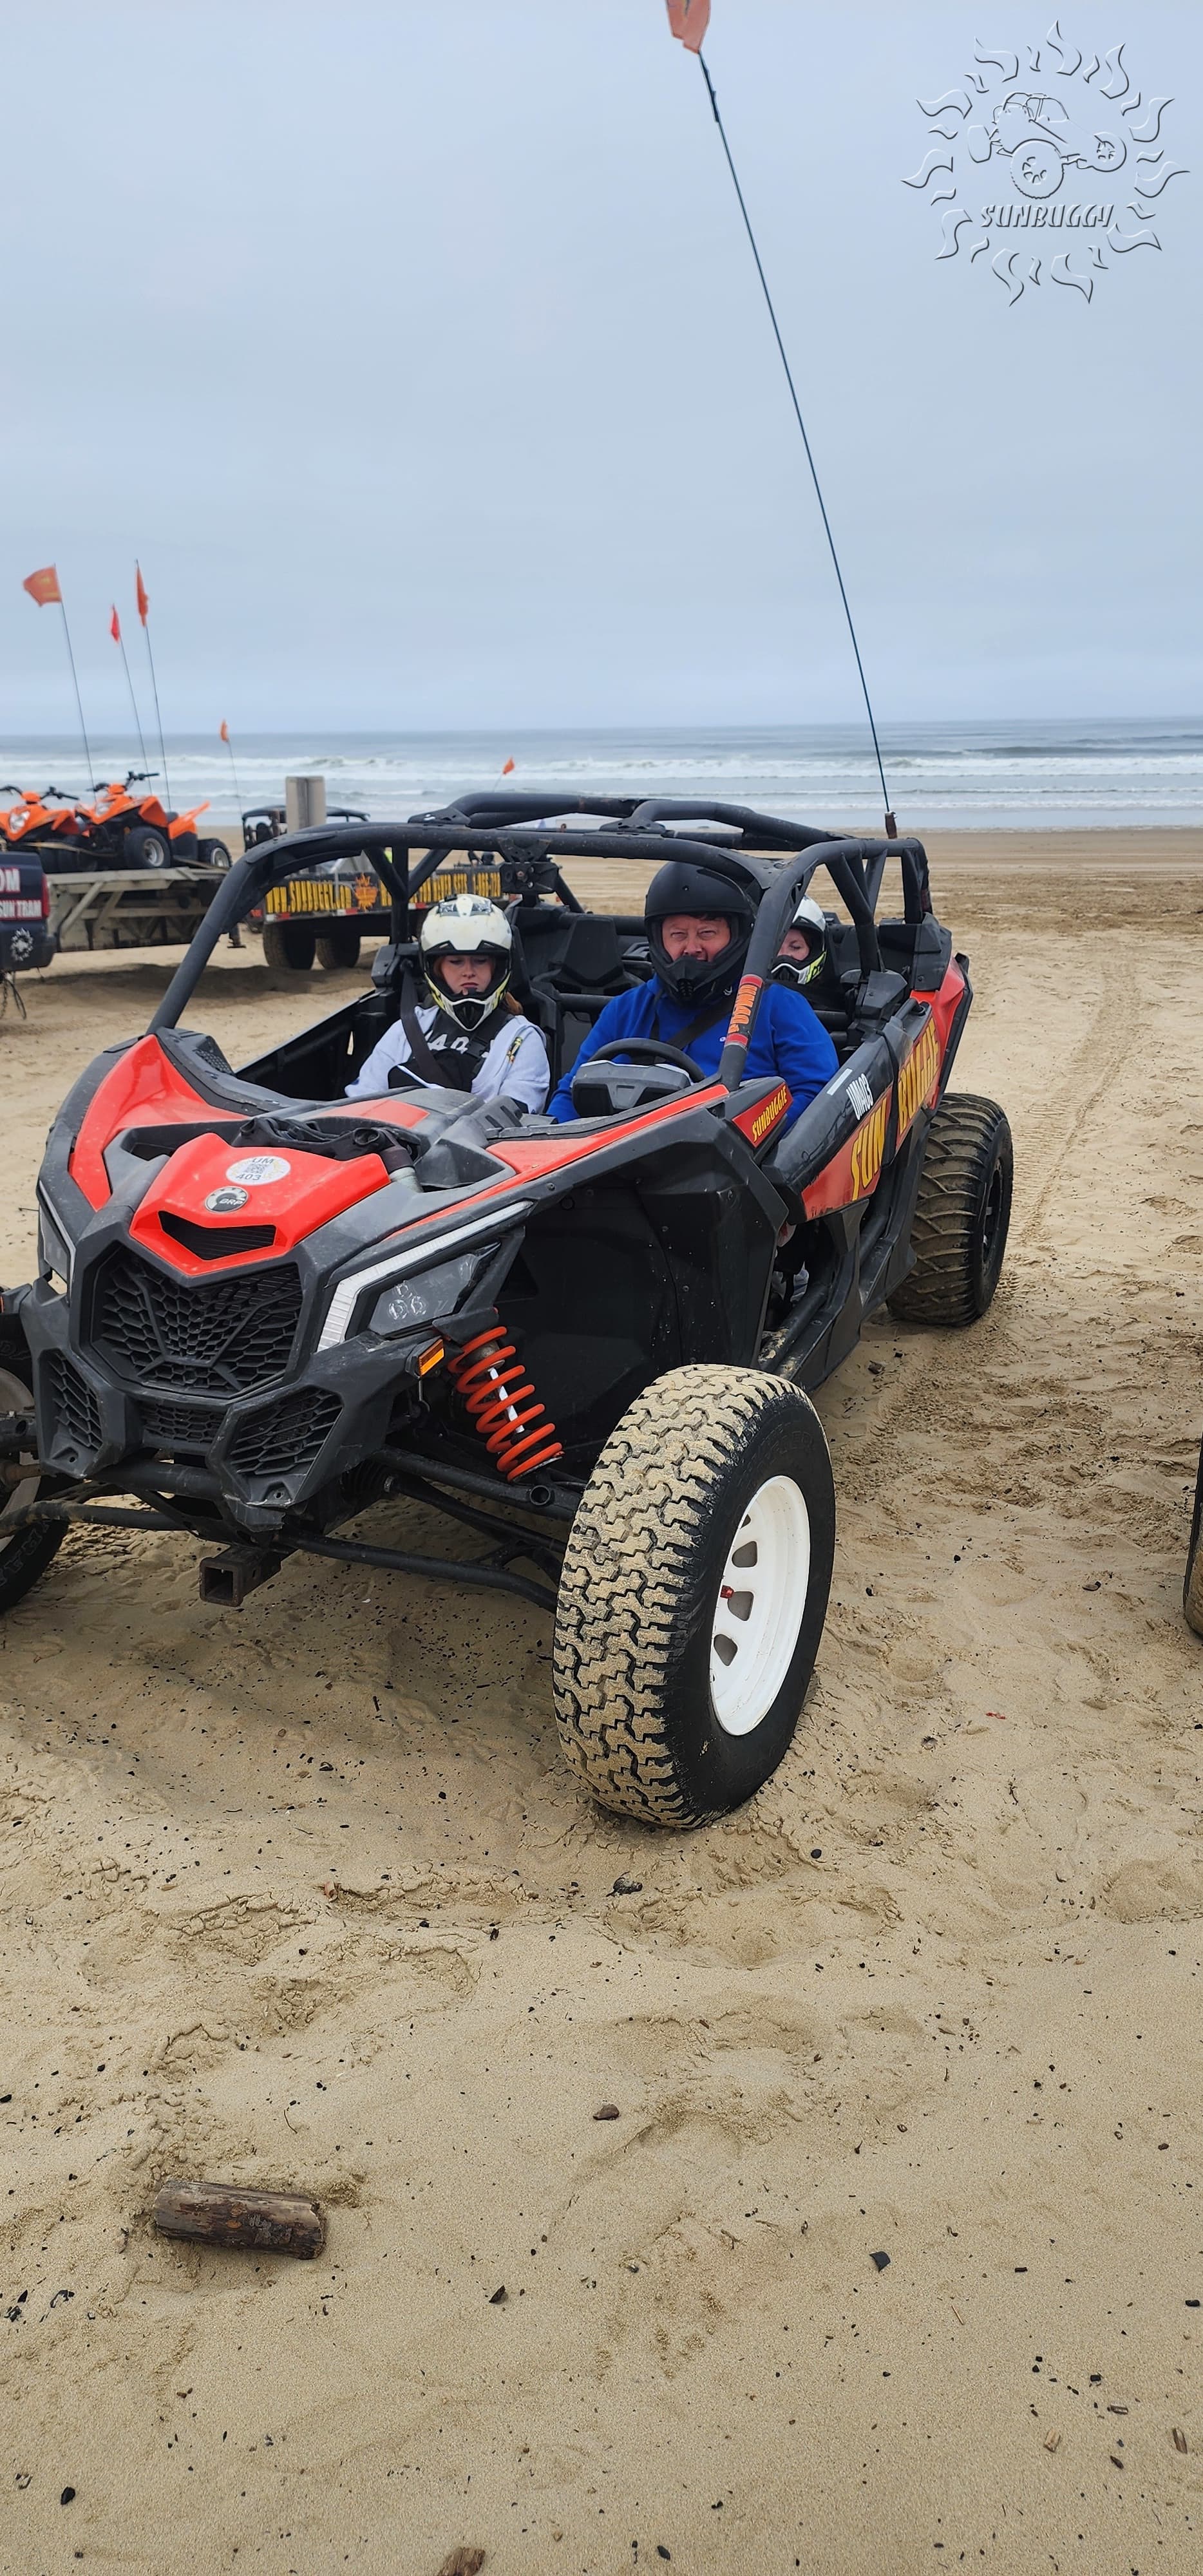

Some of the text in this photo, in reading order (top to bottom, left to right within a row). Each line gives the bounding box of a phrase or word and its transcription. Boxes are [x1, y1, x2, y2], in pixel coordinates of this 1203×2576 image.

[752, 1085, 788, 1142] SUNBUGGIE
[851, 1017, 940, 1202] SUN BUGGIE
[219, 1197, 244, 1206] BRP
